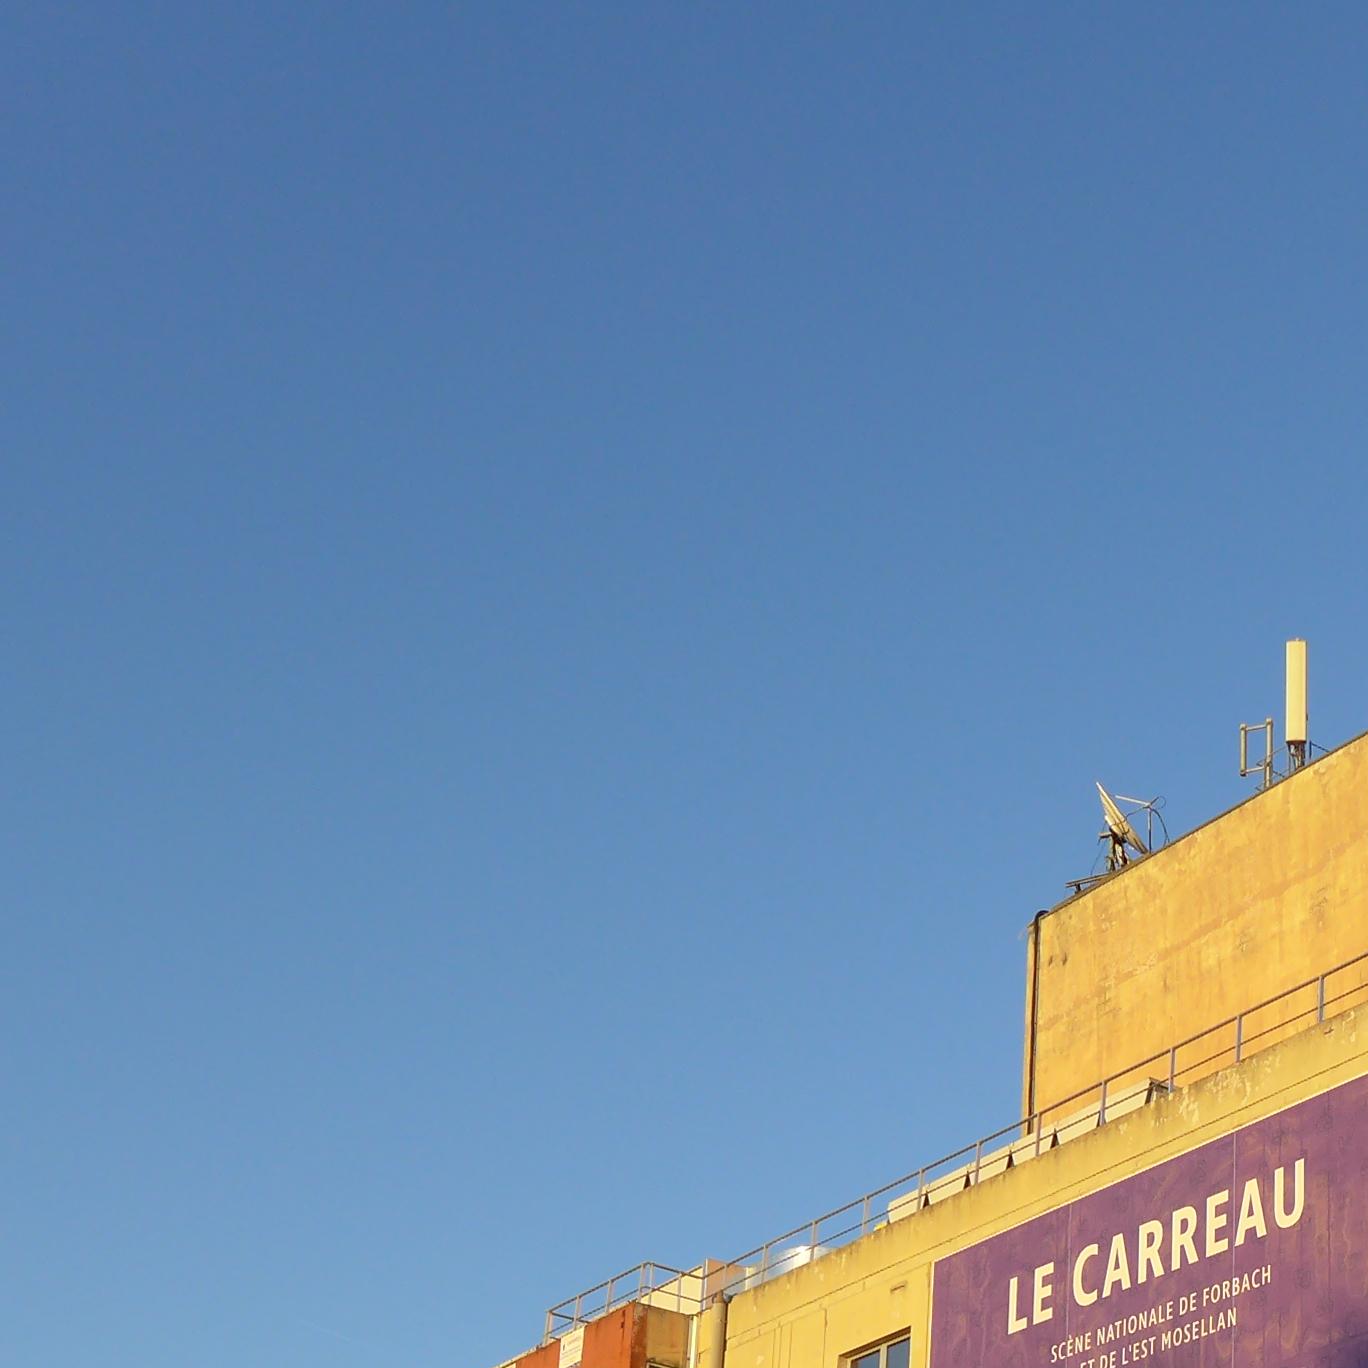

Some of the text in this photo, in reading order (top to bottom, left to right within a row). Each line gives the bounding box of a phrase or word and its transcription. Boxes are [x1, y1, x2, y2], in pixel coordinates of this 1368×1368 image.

[1007, 1158, 1305, 1335] LE CARREAU
[1050, 1264, 1272, 1363] SCÈNE NATIONALE DE FORBACH
[1121, 1337, 1155, 1366] L'EST
[1161, 1307, 1237, 1351] MOSELLAN
